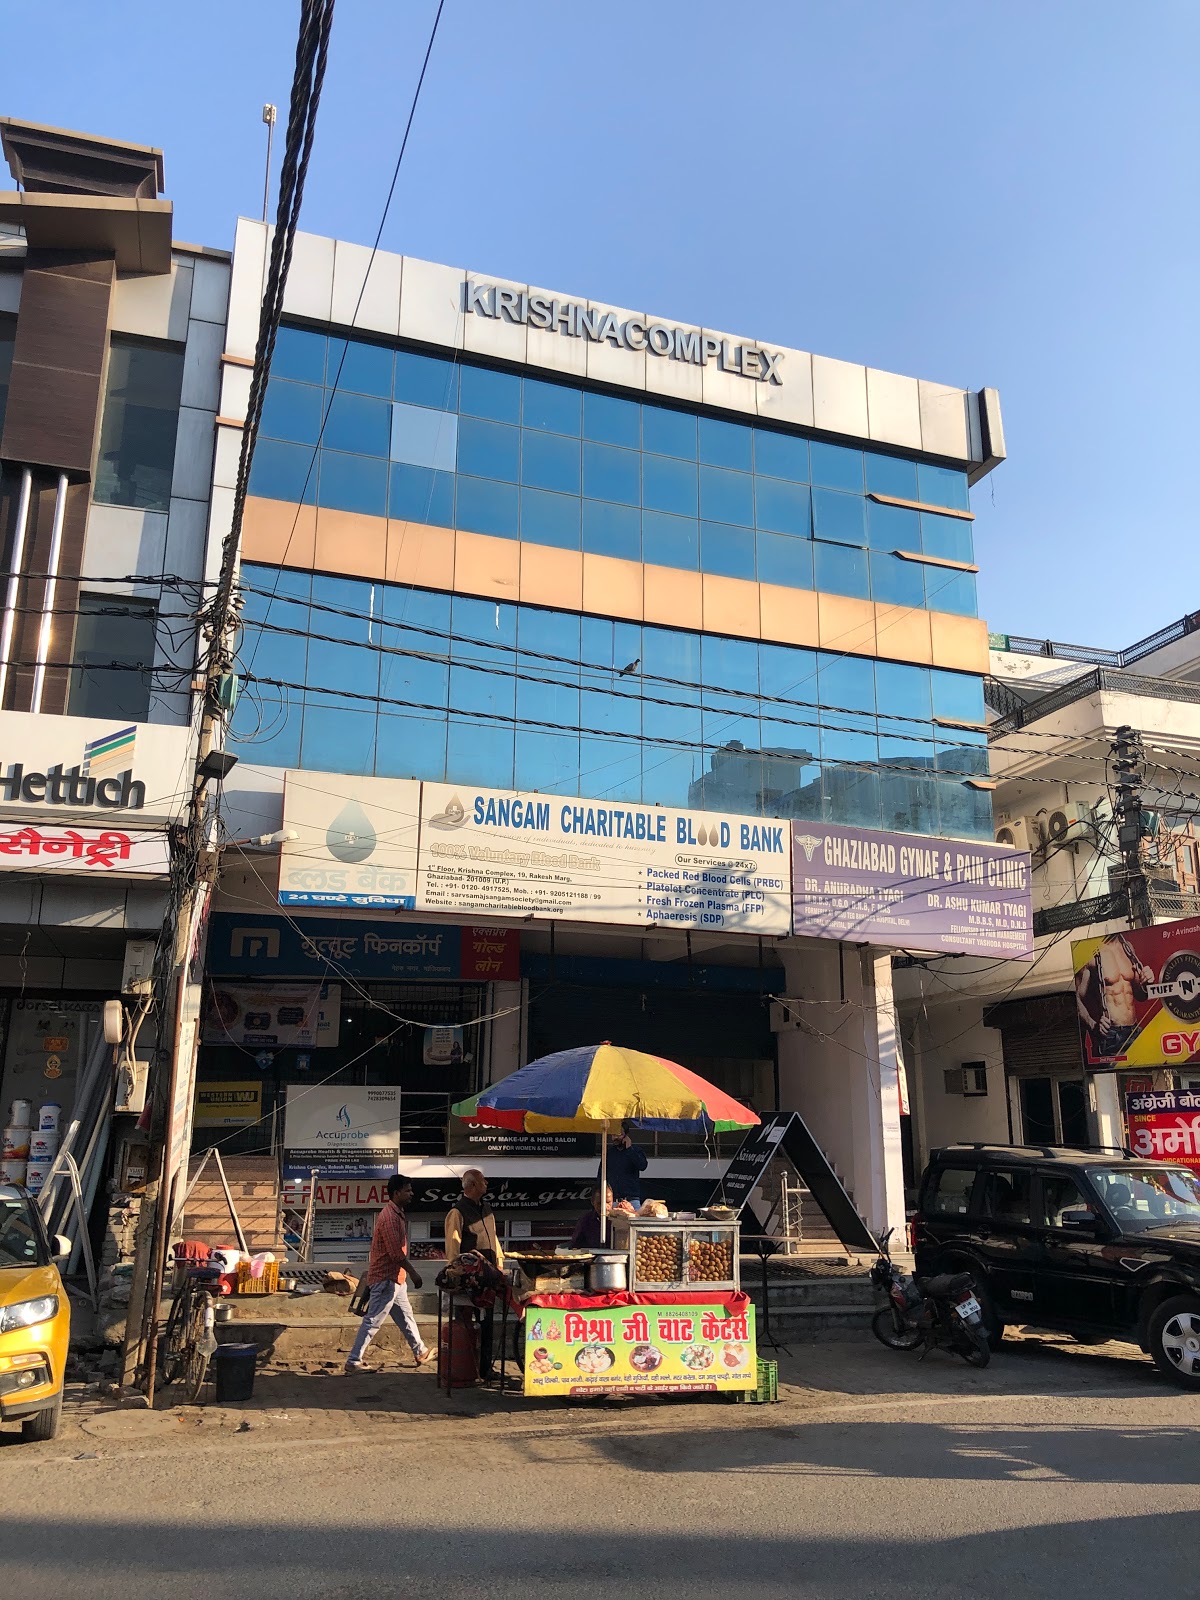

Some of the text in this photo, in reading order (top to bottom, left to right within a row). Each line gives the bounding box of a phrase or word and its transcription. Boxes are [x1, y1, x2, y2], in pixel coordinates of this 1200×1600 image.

[473, 796, 550, 831] SANGAM
[561, 805, 666, 842] CHARITABLE
[740, 824, 784, 854] BANK
[430, 842, 601, 872] 100% Voluntary Blood Bank
[677, 855, 691, 864] Our
[693, 857, 726, 867] Services
[824, 835, 1027, 891] GHAZIABAD GYNAE & PAIN CLINIC
[437, 865, 456, 873] Floor,
[457, 867, 484, 875] Krishna
[485, 869, 516, 878] Complex,
[466, 875, 491, 883] 201009
[646, 868, 784, 890] Packed Red Blood Cells (PRBC)
[646, 882, 765, 900] Platelet Concentrate (PLC)
[804, 878, 904, 903] DR. ANURADHA TYAGI
[646, 895, 764, 915] Fresh Frozen Plasma (FFP)
[927, 894, 1027, 918] DR. ASHU KUMAR TYAGI
[646, 909, 724, 925] Aphaeresis (SDP)
[941, 935, 975, 945] CONSULTANT
[1162, 930, 1171, 940] By
[472, 938, 507, 954] गोल्ड
[475, 957, 503, 973] लोन
[1150, 984, 1174, 995] TUFF
[1131, 1092, 1176, 1112] अंग्रेजी
[1134, 1114, 1157, 1122] SINCE
[316, 1131, 370, 1141] Accuprobe
[420, 1188, 530, 1202] Scisor
[565, 1312, 614, 1343] मिश्रा
[621, 1312, 650, 1342] जी
[658, 1318, 693, 1341] चाट
